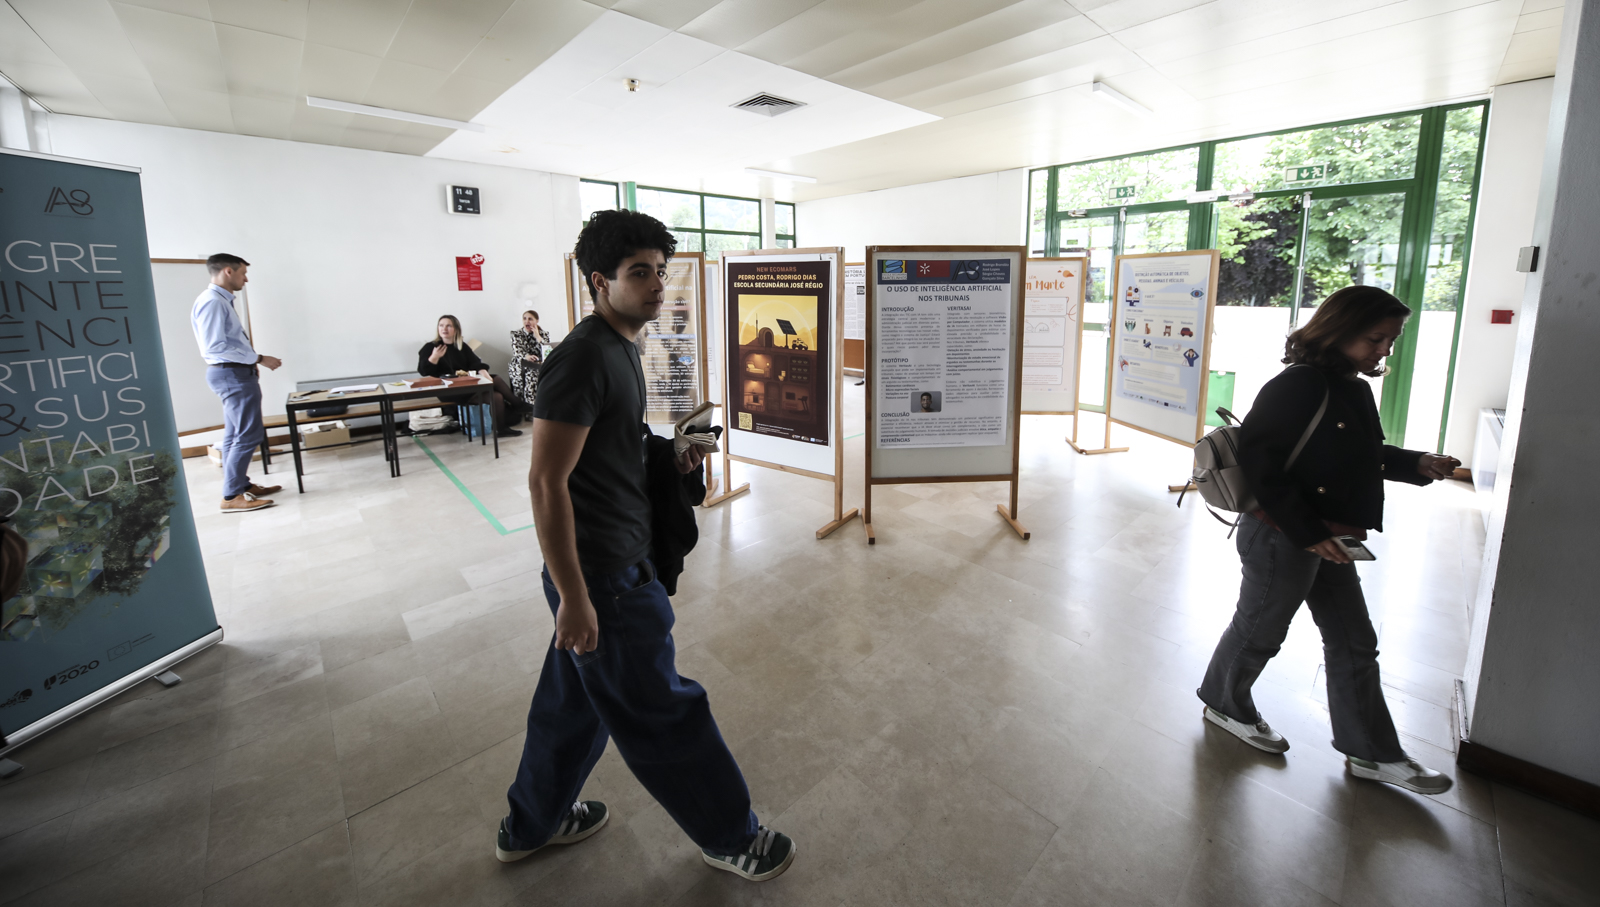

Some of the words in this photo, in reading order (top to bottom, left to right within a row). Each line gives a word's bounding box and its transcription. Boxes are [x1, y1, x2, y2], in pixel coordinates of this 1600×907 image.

[1036, 279, 1065, 290] Marte
[34, 386, 146, 428] SUS
[58, 660, 100, 685] 2020
